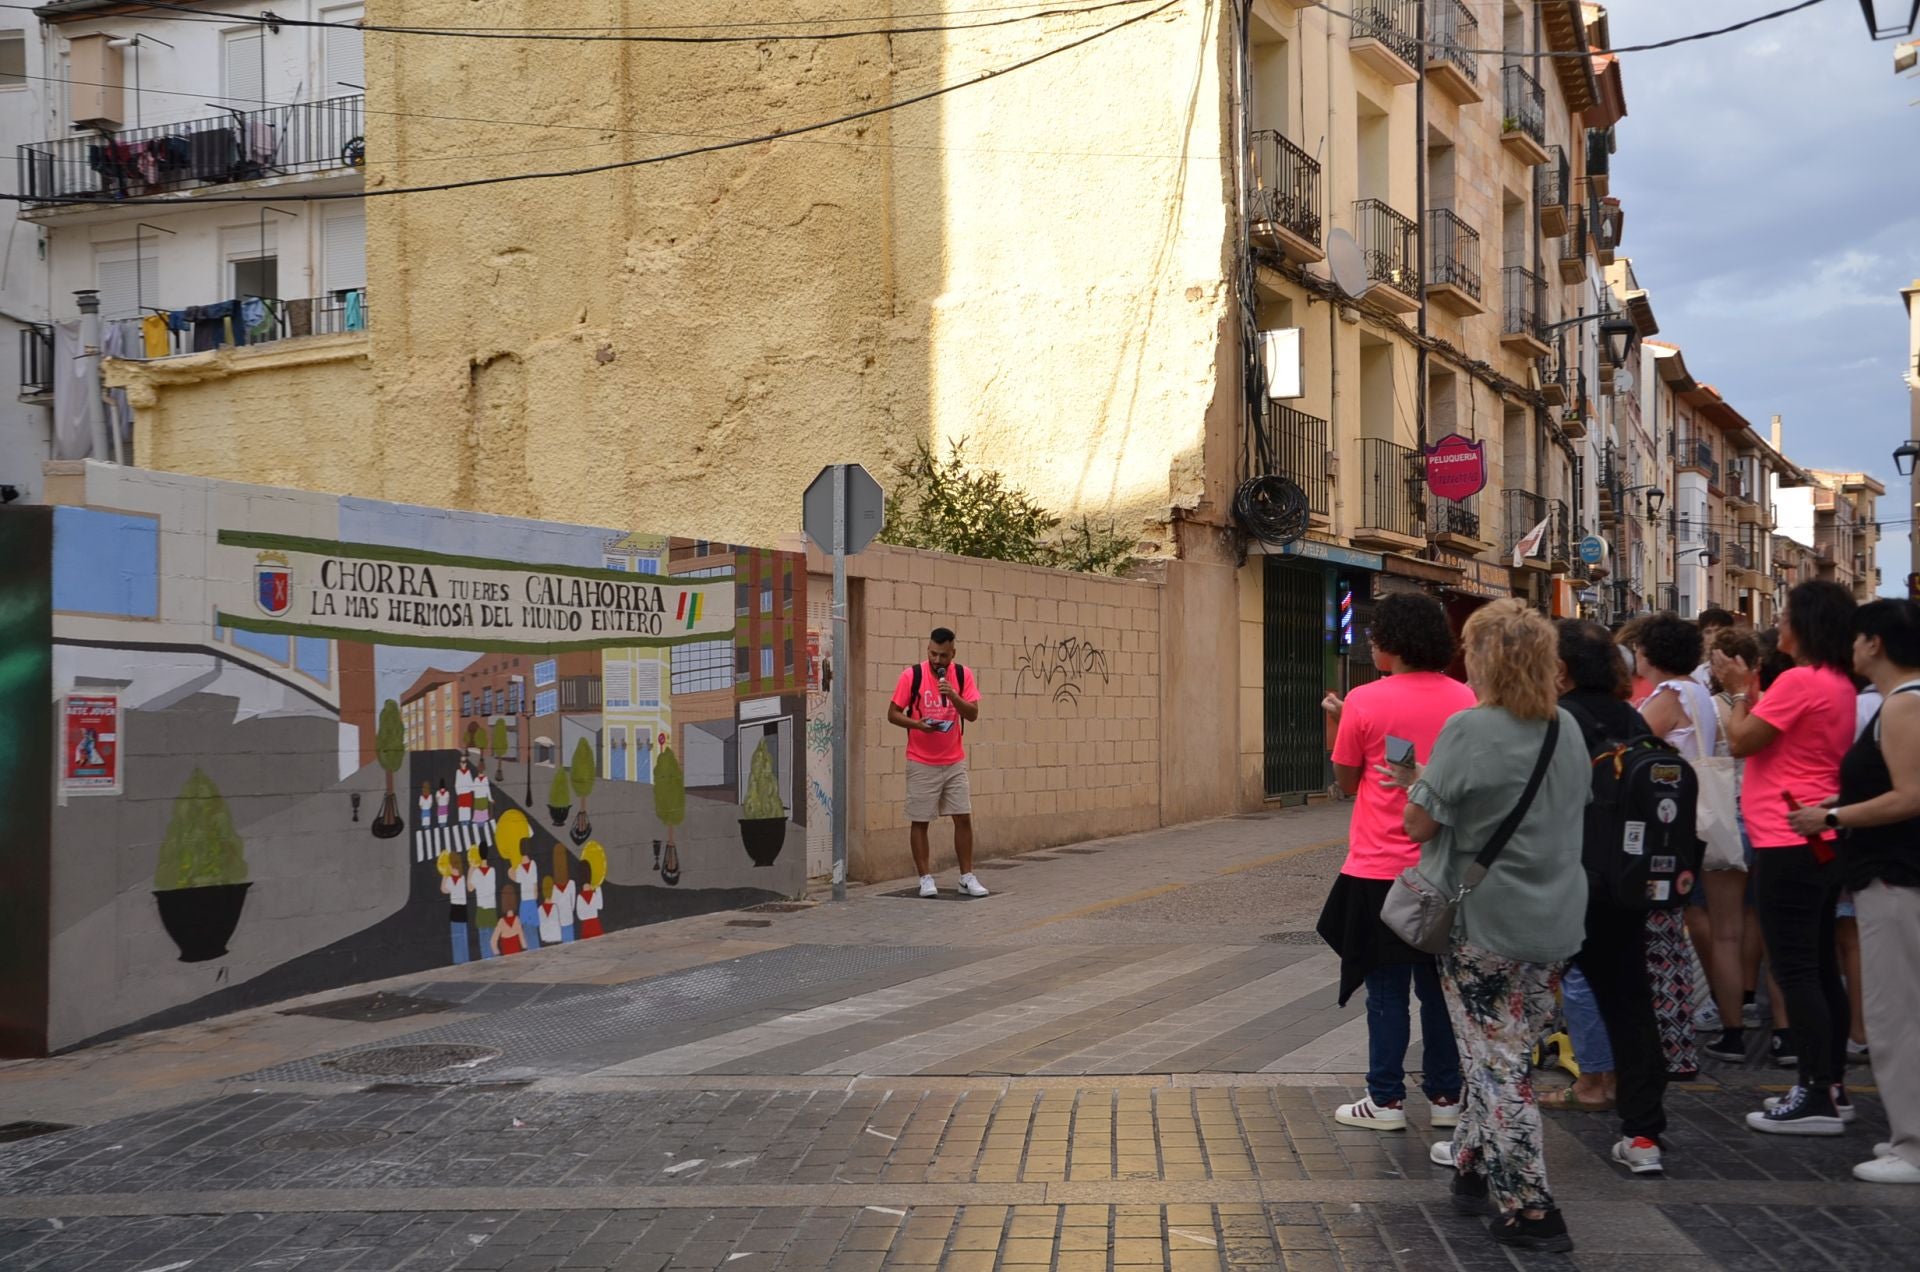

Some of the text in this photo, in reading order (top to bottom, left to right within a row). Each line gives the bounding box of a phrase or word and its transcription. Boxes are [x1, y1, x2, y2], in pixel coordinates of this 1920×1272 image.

[1429, 452, 1478, 464] PELUQUERIA
[321, 559, 438, 598] CHORRA
[473, 582, 509, 601] ERES
[525, 575, 666, 613] CALAHORRA
[311, 591, 662, 636] LA MAS HERMOSA DEL MUNDO ENTERO
